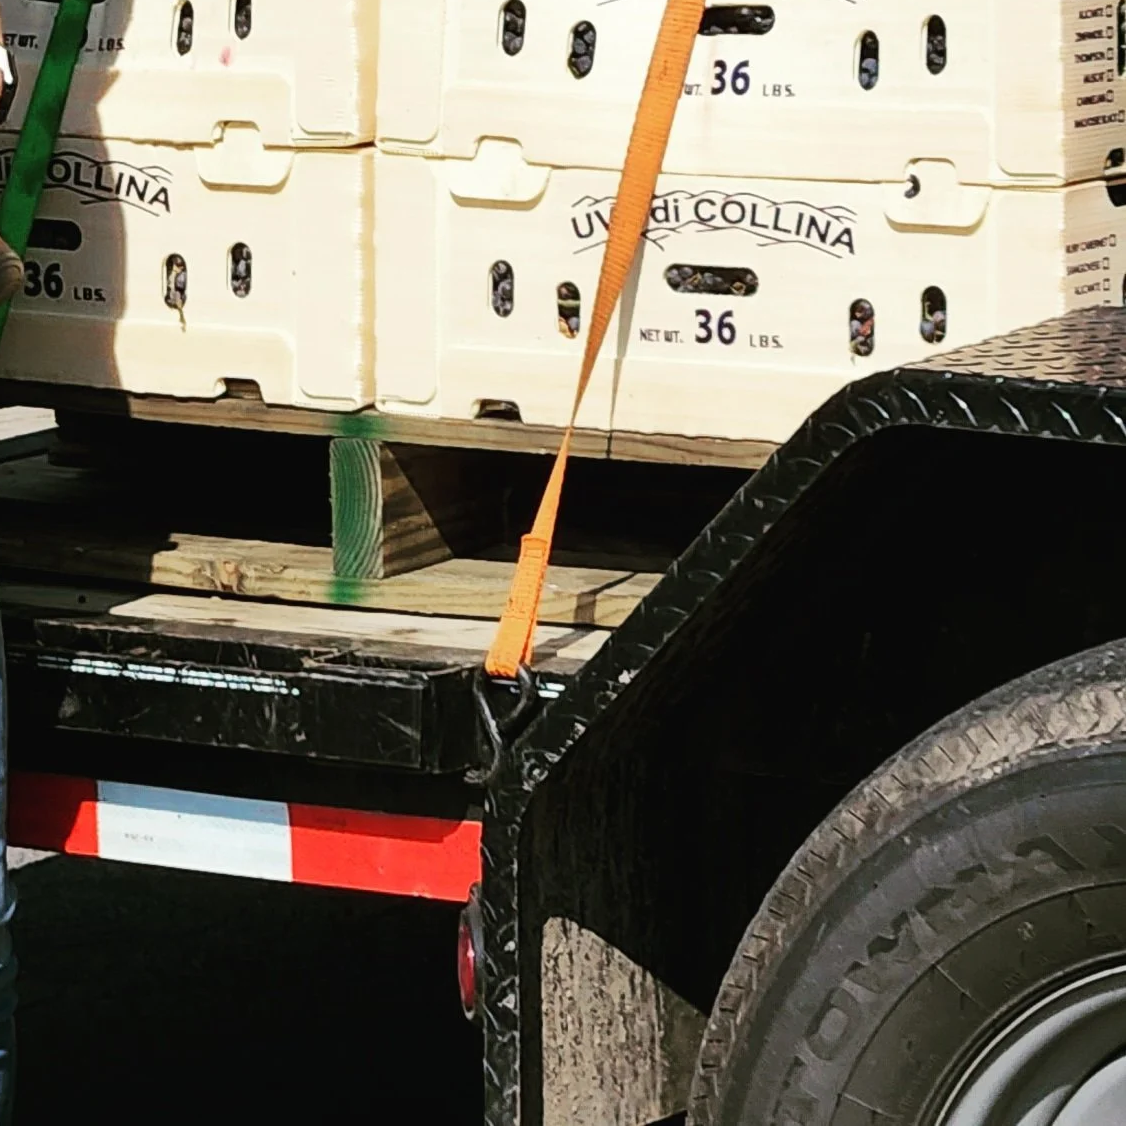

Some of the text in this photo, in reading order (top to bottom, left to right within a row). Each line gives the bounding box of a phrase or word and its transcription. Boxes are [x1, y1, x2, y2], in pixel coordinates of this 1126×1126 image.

[710, 59, 751, 96] 36
[762, 83, 796, 98] LBS.
[45, 157, 171, 214] OLLINA
[649, 198, 680, 224] di
[693, 197, 855, 255] COLLINA
[24, 260, 106, 302] 36 LBS.
[640, 328, 661, 342] NET
[694, 309, 737, 345] 36
[749, 334, 784, 349] LBS.
